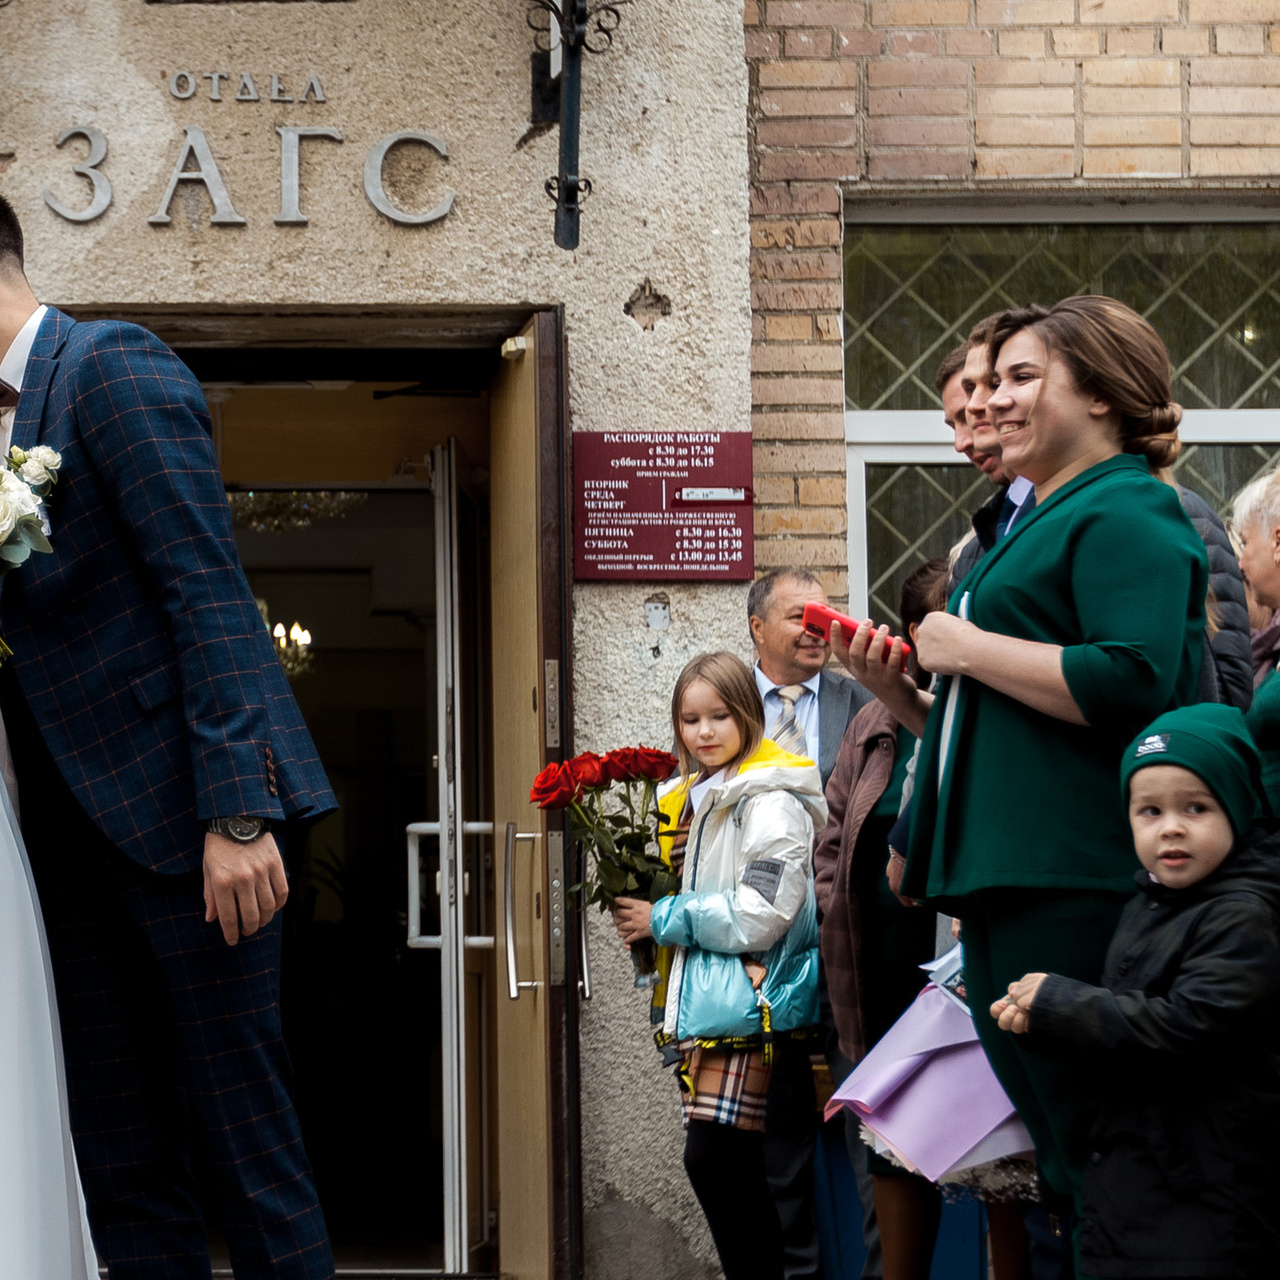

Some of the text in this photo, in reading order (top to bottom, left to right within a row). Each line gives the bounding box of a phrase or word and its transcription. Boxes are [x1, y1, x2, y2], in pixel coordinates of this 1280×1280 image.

[168, 70, 326, 103] ОТДЕЛ
[43, 125, 457, 226] ЗАГС
[603, 433, 720, 444] РАСПОРЯДОК РАБОТЫ
[648, 446, 714, 456] с 8.30 до 17.30
[610, 457, 714, 469] суббота с 8.30 до 16.15
[584, 480, 629, 489] ВТОРНИК
[584, 490, 614, 500] СРЕДА
[584, 500, 626, 510] ЧЕТВЕРГ
[584, 528, 634, 537] ПЯТНИЦА
[682, 528, 702, 537] 8.30
[704, 530, 716, 538] до
[718, 528, 742, 537] 16.30
[584, 540, 628, 548] СУББОТА
[676, 541, 681, 549] с
[682, 540, 702, 549] 8.30
[704, 541, 716, 550] до
[670, 553, 676, 561] с
[679, 551, 702, 561] 13.00
[704, 553, 716, 562] до
[718, 551, 742, 561] 13.45
